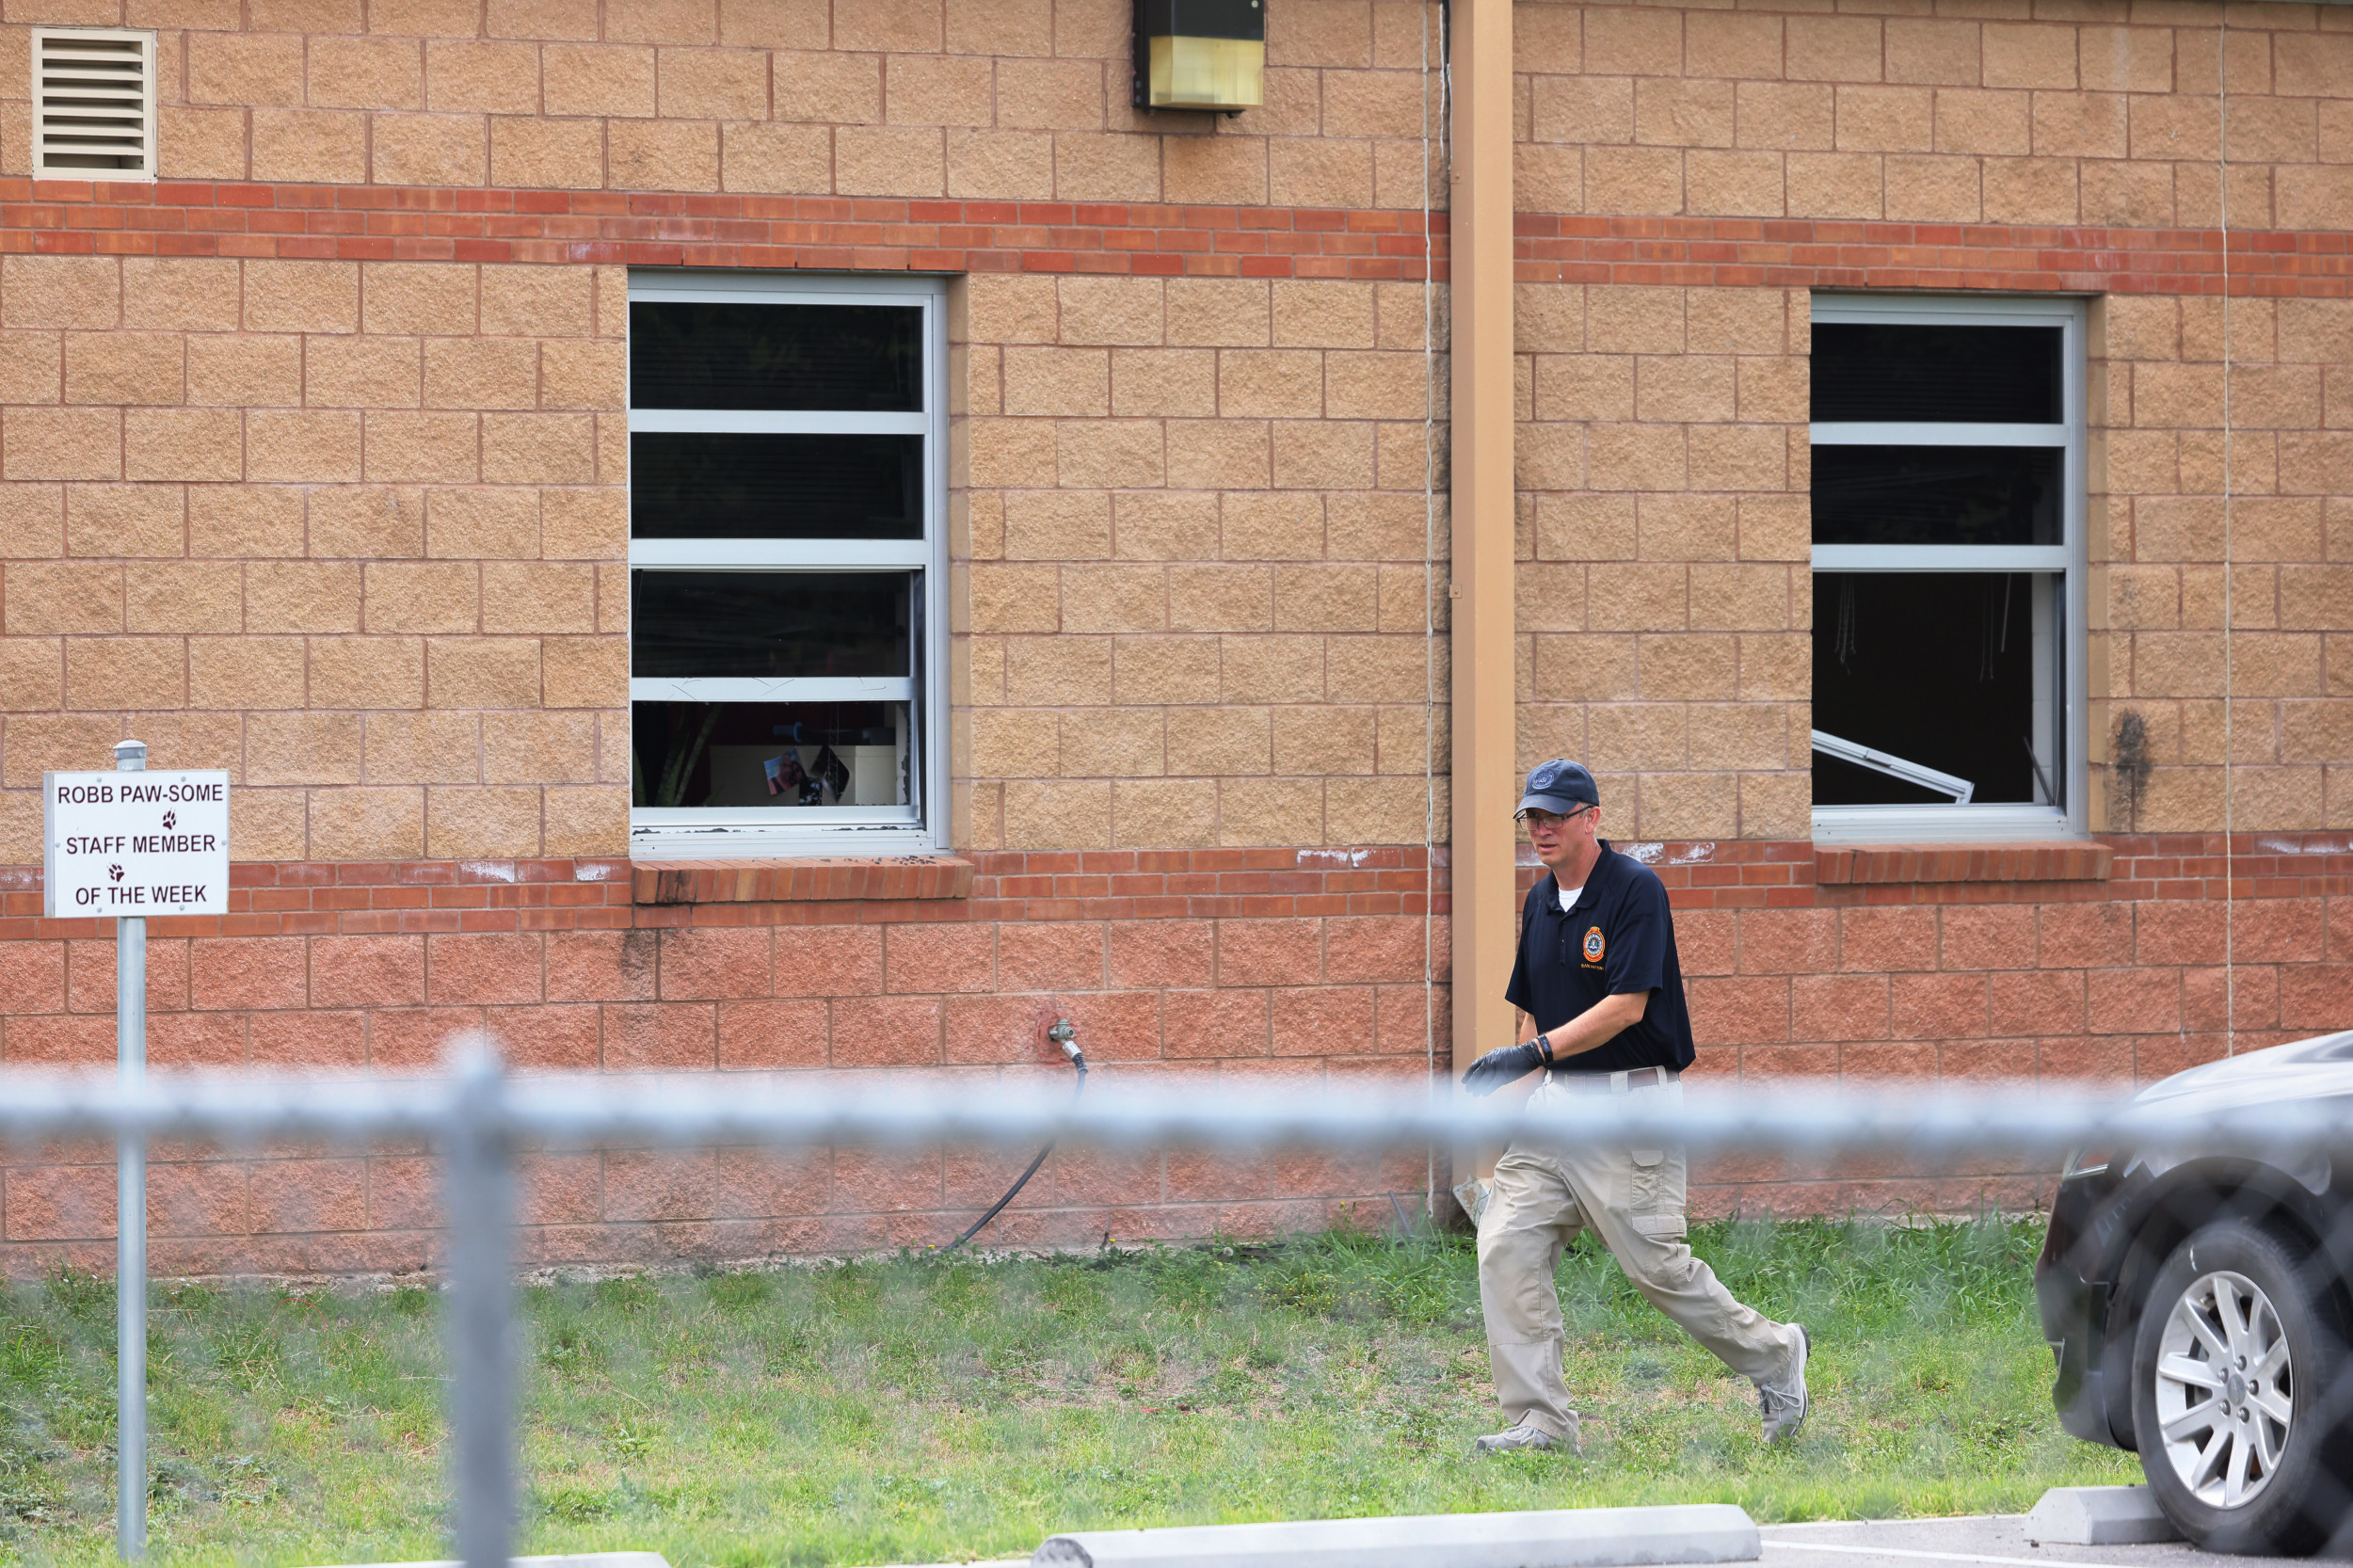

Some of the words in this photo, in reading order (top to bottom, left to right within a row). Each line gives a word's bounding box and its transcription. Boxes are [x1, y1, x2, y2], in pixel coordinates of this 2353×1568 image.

[58, 786, 114, 804] ROBB
[120, 784, 223, 803] PAW-SOME
[66, 836, 126, 855] STAFF
[133, 835, 216, 853] MEMBER
[75, 887, 102, 905] OF
[107, 886, 146, 904] THE
[151, 885, 207, 904] WEEK
